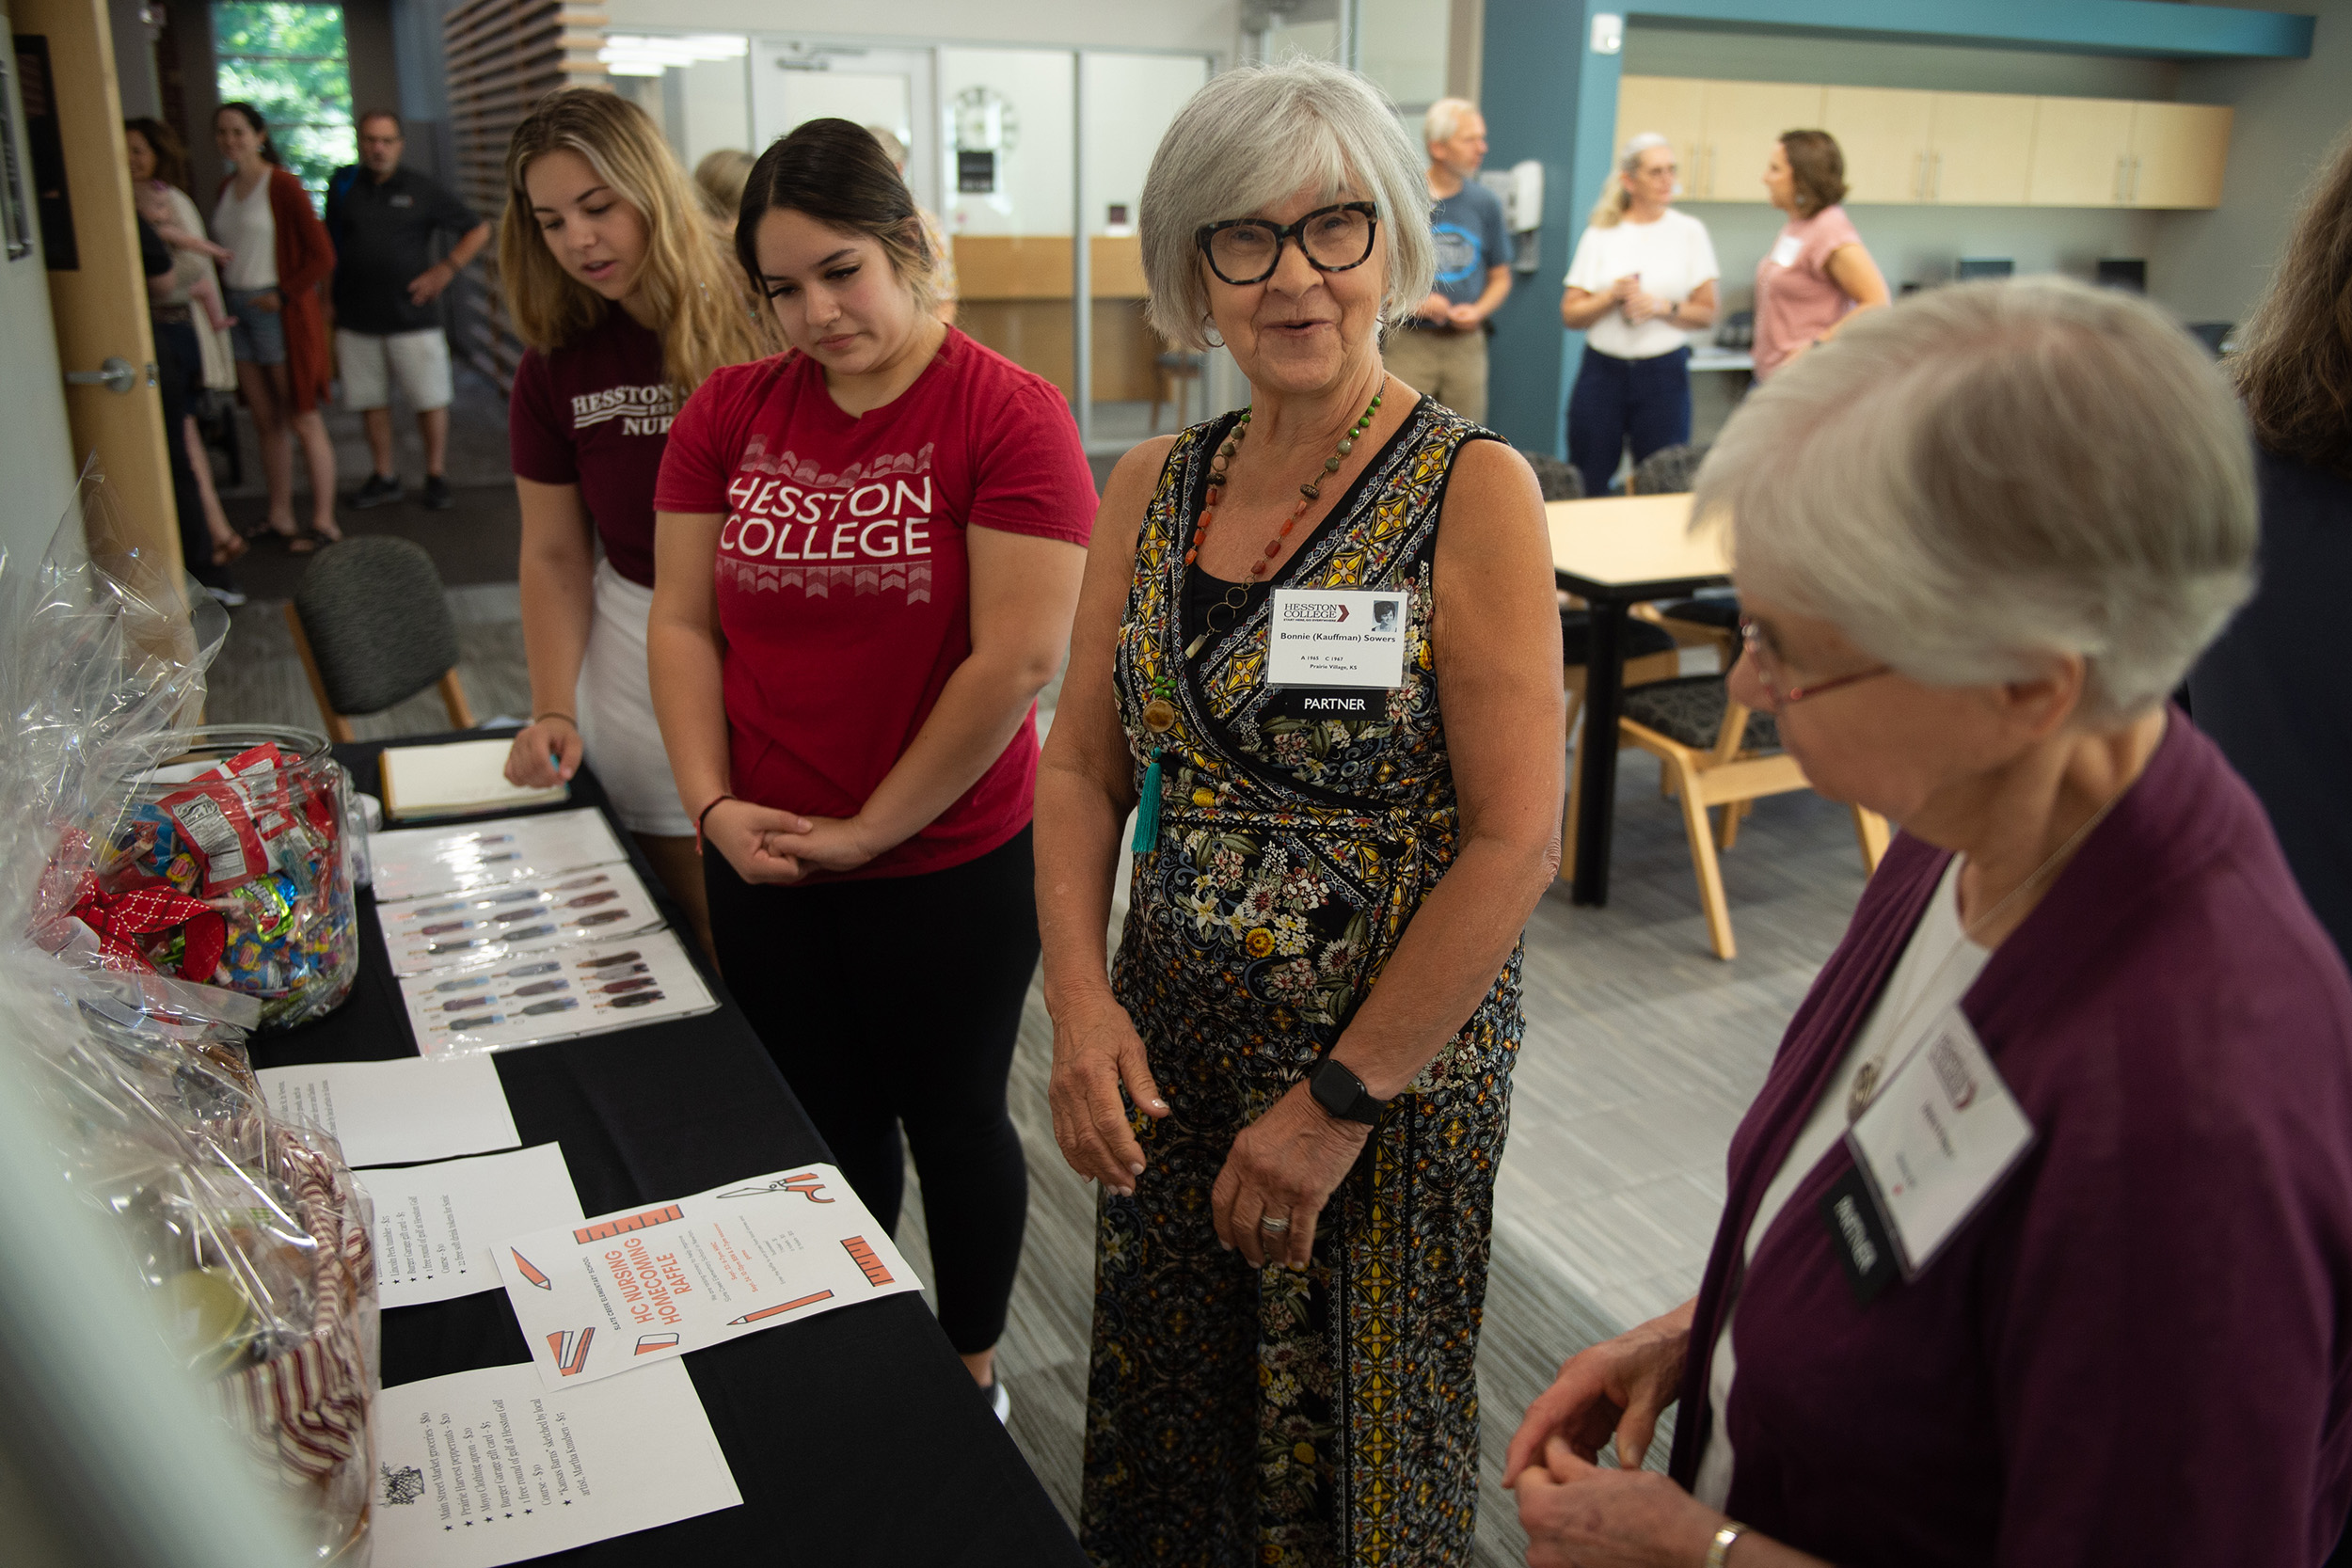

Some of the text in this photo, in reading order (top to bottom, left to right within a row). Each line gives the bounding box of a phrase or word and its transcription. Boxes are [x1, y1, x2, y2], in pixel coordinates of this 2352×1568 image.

[572, 385, 673, 416] HESSTON
[727, 476, 931, 526] HESSTON
[720, 518, 931, 561] COLLEGE
[1312, 633, 1361, 642] (Kauffman)
[1304, 698, 1365, 710] PARTNER
[625, 1238, 682, 1325] HOMECOMING
[657, 1253, 692, 1295] RAFFLE
[582, 1257, 621, 1330] SLATE CREEK ELEMENTARY SCHOOL
[605, 1250, 654, 1323] HC NURSING
[492, 1400, 504, 1412] Golf
[531, 1399, 543, 1413] local
[420, 1412, 431, 1424] $80
[439, 1413, 451, 1425] $20
[499, 1413, 512, 1437] Hesston
[423, 1429, 438, 1458] groceries
[463, 1427, 473, 1439] $20
[483, 1434, 495, 1449] card
[537, 1421, 553, 1448] sketched
[562, 1427, 576, 1453] Knudsen
[444, 1430, 461, 1465] peppernuts
[468, 1445, 480, 1464] apron
[486, 1449, 500, 1460] gift
[504, 1445, 517, 1457] golf
[429, 1458, 441, 1481] Market
[492, 1462, 503, 1484] Garage
[511, 1465, 525, 1485] round
[570, 1453, 582, 1477] Martha
[452, 1466, 465, 1492] Harvest
[472, 1465, 485, 1493] Clothing
[577, 1477, 590, 1496] artist,
[435, 1481, 447, 1502] Street
[480, 1493, 490, 1513] Moyo
[498, 1485, 511, 1508] Burger
[518, 1486, 529, 1499] free
[538, 1482, 551, 1506] Course
[438, 1502, 450, 1520] Main
[457, 1493, 470, 1516] Prairie
